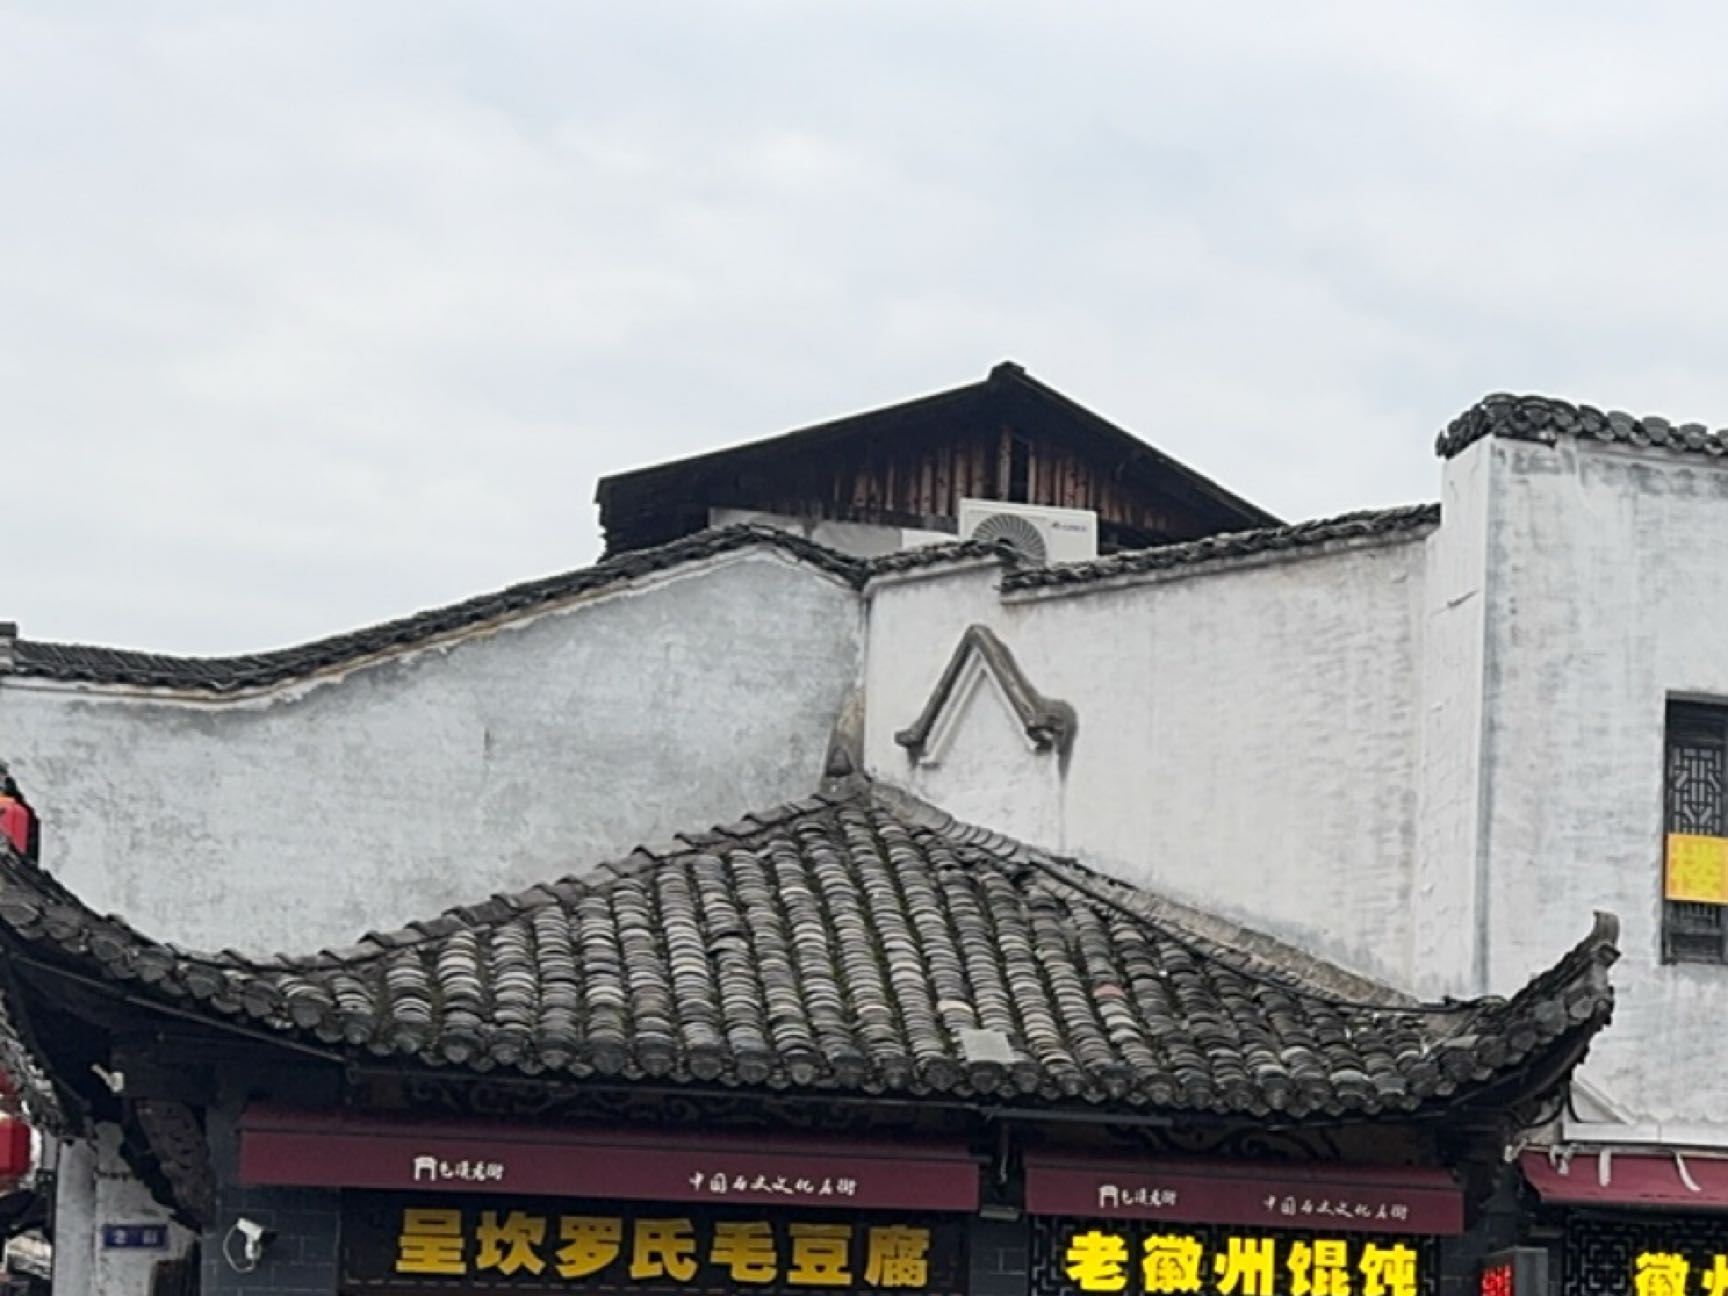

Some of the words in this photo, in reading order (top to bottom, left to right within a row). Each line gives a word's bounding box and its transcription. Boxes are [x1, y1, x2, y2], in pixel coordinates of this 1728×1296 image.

[396, 1208, 931, 1288] 呈坎罗氏毛豆腐
